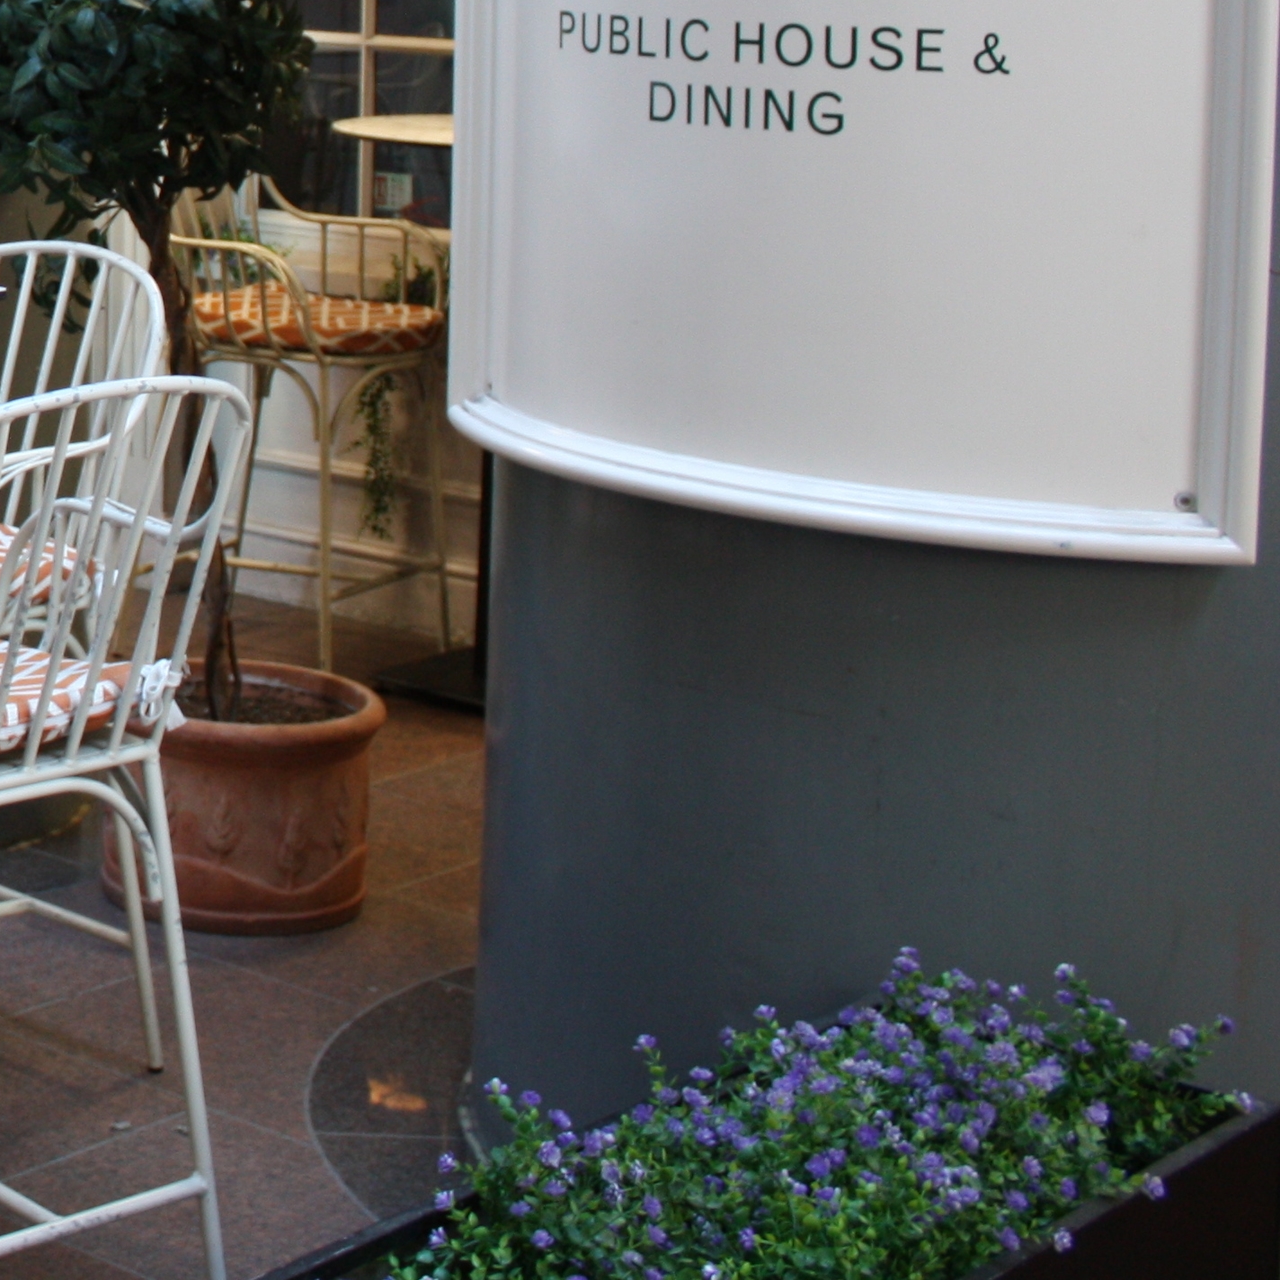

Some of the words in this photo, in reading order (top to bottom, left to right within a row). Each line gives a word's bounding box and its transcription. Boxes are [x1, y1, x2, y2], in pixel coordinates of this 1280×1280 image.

[558, 9, 711, 63] PUBLIC
[732, 20, 946, 74] HOUSE
[972, 31, 1011, 76] &
[647, 80, 846, 137] DINING
